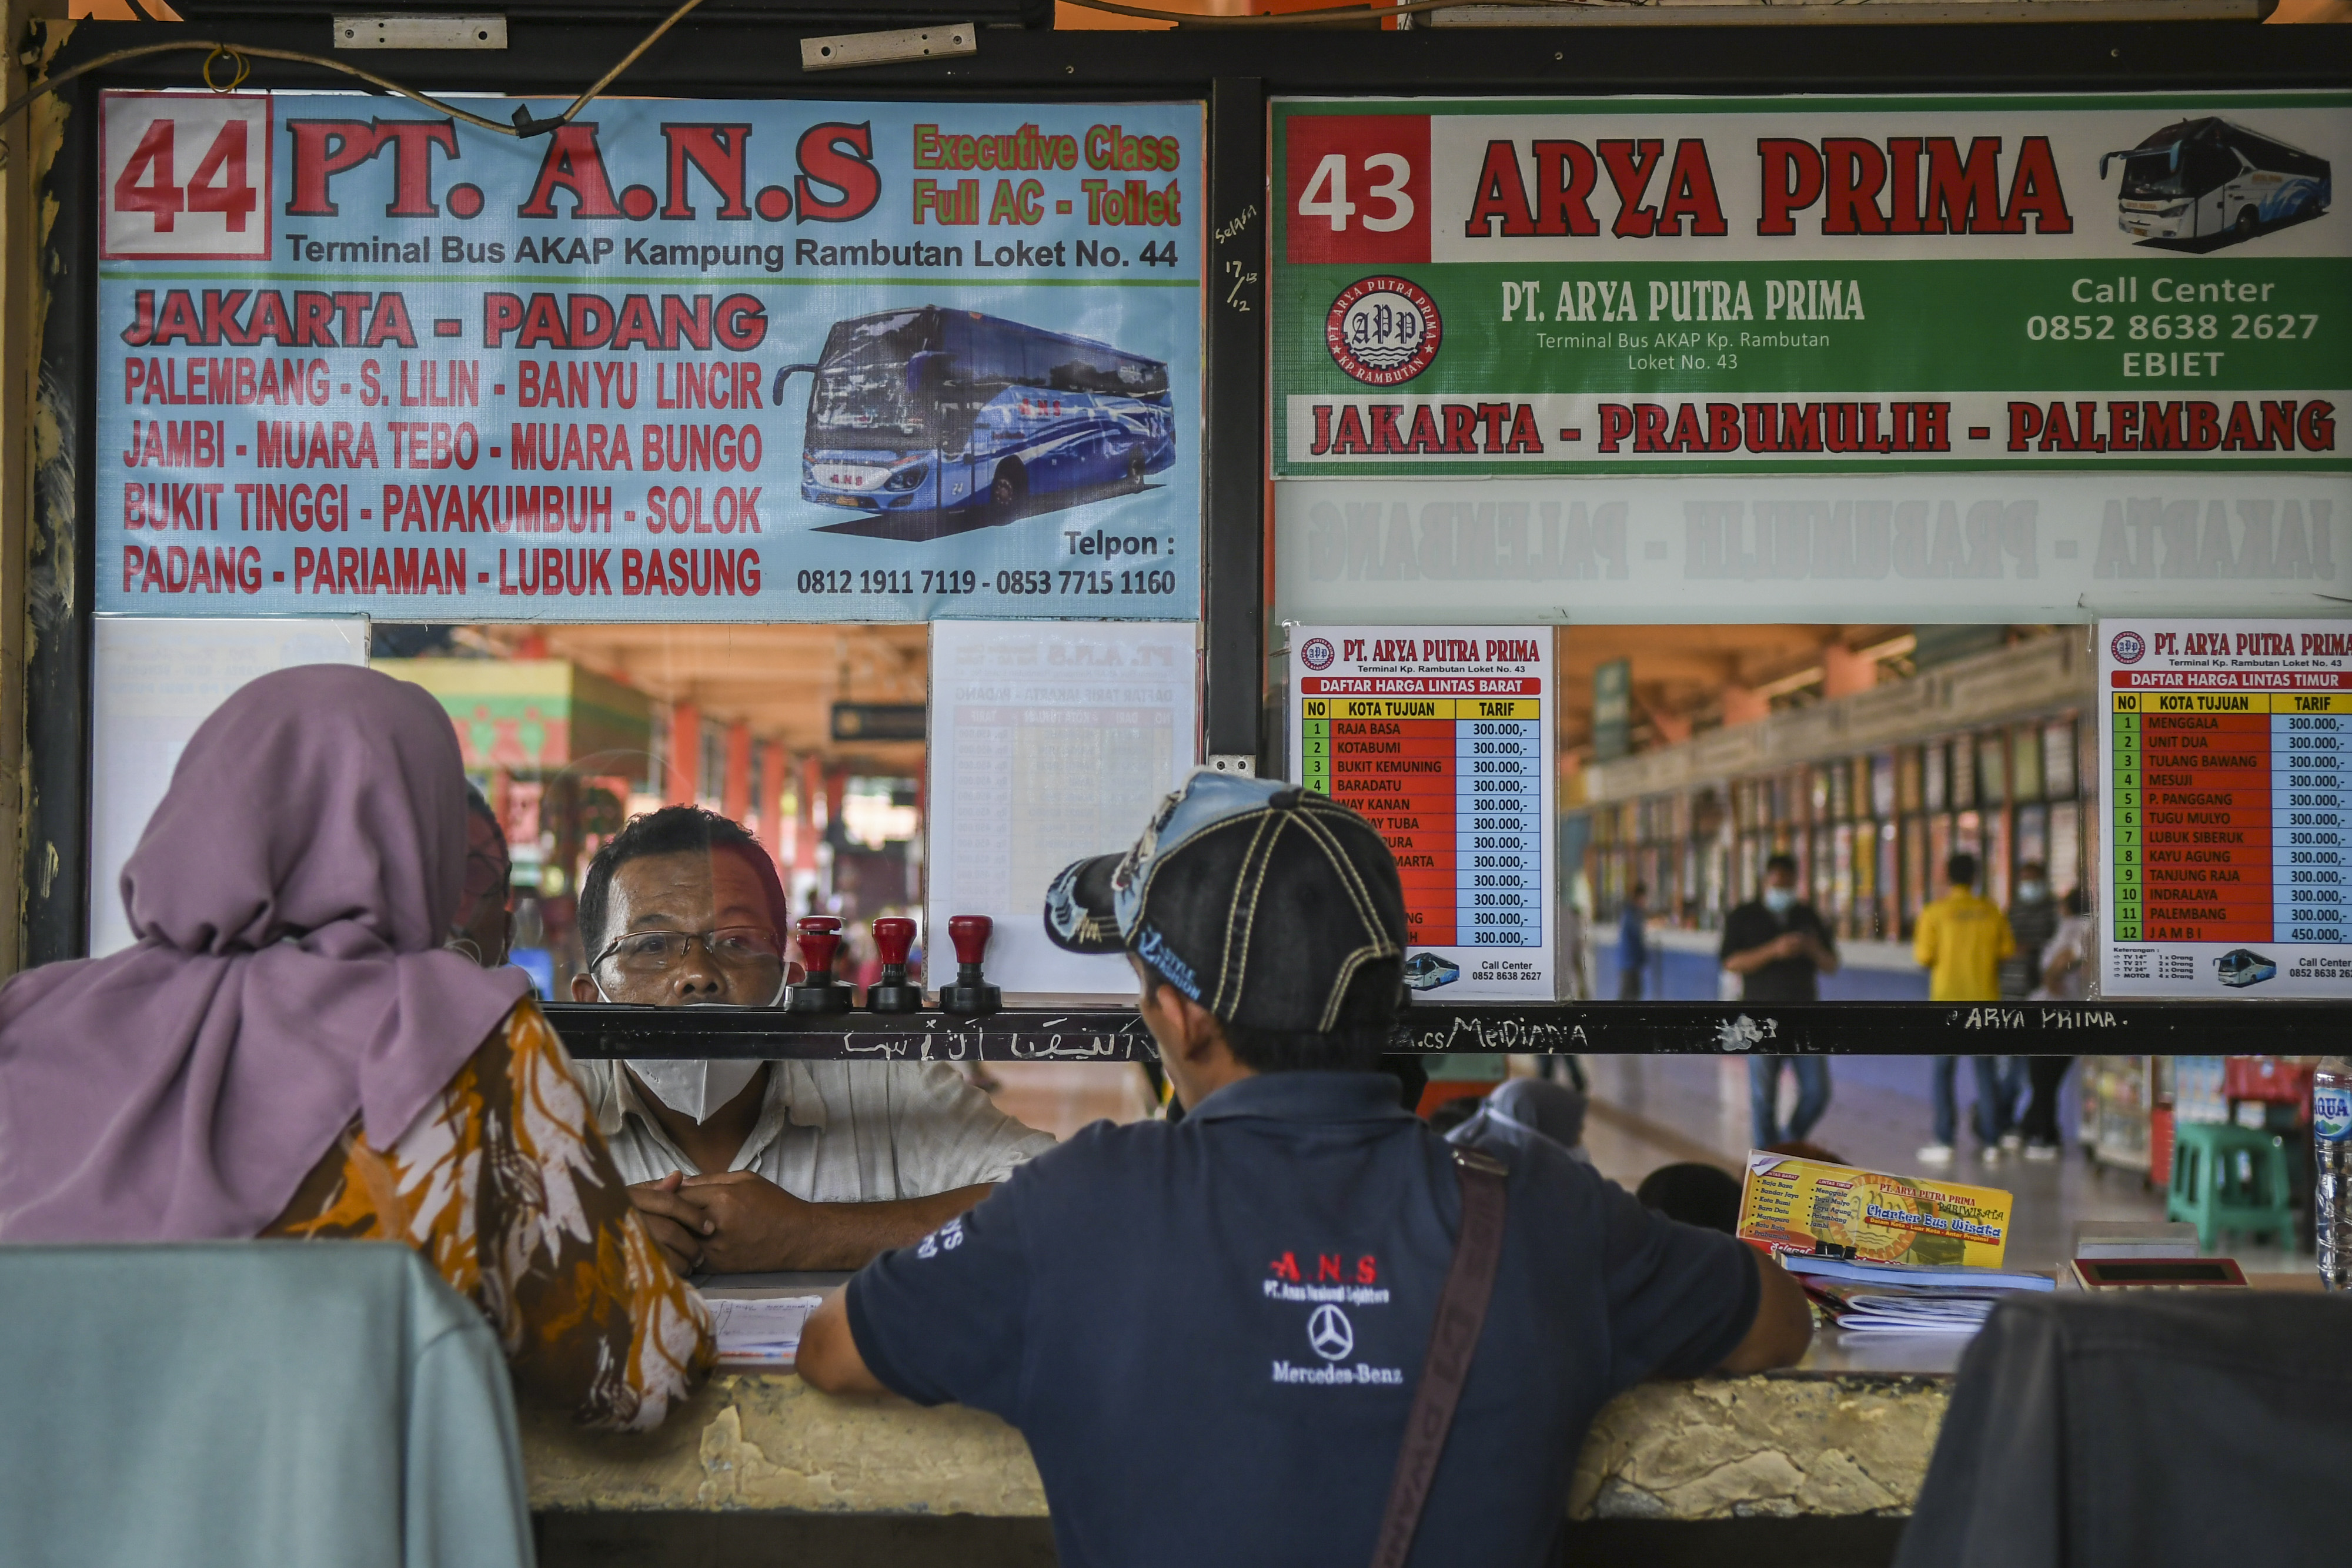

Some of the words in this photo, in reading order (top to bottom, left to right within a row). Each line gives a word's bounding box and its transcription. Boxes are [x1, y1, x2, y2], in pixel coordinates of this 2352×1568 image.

[913, 122, 1077, 171] Executive
[1085, 123, 1180, 172] Class
[113, 119, 258, 233] 44
[285, 115, 485, 219] PT.
[518, 120, 882, 226] A.N.S
[1297, 152, 1414, 233] 43
[1465, 138, 1729, 239] ARYA
[1757, 135, 2074, 236] PRIMA
[913, 178, 980, 226] Full
[988, 178, 1044, 226] AC
[1081, 178, 1181, 227] Toilet
[286, 234, 430, 263] Terminal
[442, 236, 505, 263] Bus
[513, 236, 614, 265] AKAP
[625, 238, 784, 272] Kampung
[796, 238, 963, 268] Rambutan
[975, 239, 1066, 268] Loket
[1075, 239, 1130, 268] No.
[1139, 240, 1178, 268] 44
[1501, 280, 1546, 323] PT.
[1555, 280, 1638, 322] ARYA
[1649, 280, 1753, 322] PUTRA
[1766, 279, 1866, 322] PRIMA
[2072, 276, 2137, 304] Call
[2151, 278, 2275, 304] Center
[119, 289, 418, 348] JAKARTA
[483, 292, 768, 352] PADANG
[1328, 323, 1339, 342] PT.
[1334, 287, 1362, 317] ARYA
[1367, 280, 1412, 297] PUTRA
[1415, 297, 1436, 339] PRIMA
[2026, 314, 2116, 342] 0852
[2129, 314, 2218, 340] 8638
[2231, 313, 2320, 340] 2627
[1536, 331, 1612, 350] Terminal
[1618, 331, 1649, 350] Bus
[1655, 331, 1701, 349] AKAP
[1707, 331, 1734, 353] Kp.
[1740, 330, 1830, 348] Rambutan
[1357, 357, 1424, 383] RAMBUTAN
[1628, 353, 1676, 372] Loket
[1681, 353, 1712, 372] No.
[1716, 353, 1738, 370] 43
[2122, 352, 2224, 378] EBIET
[125, 357, 330, 406] PALEMBANG
[360, 359, 389, 407] S.
[400, 359, 479, 407] LILIN
[519, 360, 637, 409] BANYU
[656, 362, 763, 410] LINCIR
[1309, 401, 1544, 456] JAKARTA
[1598, 401, 1952, 454] PRABUMULIH
[2007, 398, 2336, 454] PALEMBANG
[123, 420, 225, 469] JAMBI
[257, 420, 379, 470] MUARA
[388, 422, 479, 471] TEBO
[512, 423, 633, 471] MUARA
[642, 424, 762, 473] BUNGO
[123, 483, 223, 531] BUKIT
[235, 483, 348, 533] TINGGI
[383, 484, 612, 534] PAYAKUMBUH
[646, 486, 762, 535] SOLOK
[1065, 530, 1158, 560] Telpon
[123, 544, 262, 594] PADANG
[293, 547, 466, 596] PARIAMAN
[499, 548, 612, 597] LUBUK
[622, 548, 761, 597] BASUNG
[797, 569, 852, 595] 0812
[860, 569, 913, 595] 1911
[920, 569, 976, 595] 7119
[996, 569, 1052, 595] 0853
[1060, 569, 1114, 595] 7715
[1121, 569, 1175, 595] 1160
[1344, 639, 1367, 662] PT.
[1372, 639, 1417, 663] ARYA
[1423, 639, 1479, 663] PUTRA
[1486, 640, 1540, 662] PRIMA
[2154, 633, 2180, 656] PT.
[2184, 633, 2231, 656] ARYA
[2236, 633, 2294, 656] PUTRA
[1358, 665, 1397, 673] Terminal
[1400, 665, 1416, 674] Kp.
[1418, 665, 1465, 673] Rambutan
[1468, 665, 1494, 673] Loket
[1515, 665, 1525, 673] 43
[2131, 673, 2183, 686] DAFTAR
[2188, 674, 2236, 686] HARGA
[2243, 674, 2290, 687] LINTAS
[2295, 674, 2338, 687] TIMUR
[1321, 679, 1372, 692] DAFTAR
[1376, 680, 1425, 693] HARGA
[1428, 680, 1475, 693] LINTAS
[1479, 680, 1522, 692] BARAT
[1308, 702, 1325, 716] NO
[1349, 702, 1382, 716] KOTA
[1385, 703, 1435, 716] TUJUAN
[1479, 703, 1515, 716] TARIF
[2118, 696, 2136, 710] NO
[2160, 696, 2194, 710] KOTA
[2197, 697, 2249, 710] TUJUAN
[2295, 697, 2330, 710] TARIF
[1314, 723, 1321, 734] 1
[1338, 723, 1367, 735] RAJA
[1370, 723, 1401, 735] BASA
[1474, 723, 1528, 737] 300.000,-
[2125, 718, 2132, 728] 1
[2149, 717, 2219, 729] MENGGALA
[2289, 718, 2344, 731] 300.000,-
[1314, 742, 1321, 753] 2
[1338, 742, 1401, 754] KOTABUMI
[1474, 742, 1528, 756] 300.000,-
[1314, 761, 1321, 772] 3
[1338, 761, 1372, 773] BUKIT
[1376, 761, 1442, 773] KEMUNING
[1474, 761, 1528, 775] 300.000,-
[1314, 780, 1321, 791] 4
[1338, 780, 1402, 791] BARADATU
[1474, 780, 1528, 794] 300.000,-
[1368, 799, 1410, 810] KANAN
[1474, 799, 1528, 813] 300.000,-
[1472, 972, 1495, 981] 0852
[1497, 972, 1519, 980] 8638
[1521, 972, 1541, 980] 2627
[1482, 961, 1499, 969] Call
[1502, 961, 1532, 969] Center
[1965, 1008, 2025, 1030] ARYA
[1815, 1188, 1847, 1198] Menggala
[1880, 1183, 1893, 1192] PT.
[1896, 1186, 1916, 1196] ARYA
[1919, 1190, 1946, 1202] PUTRA
[1949, 1195, 1975, 1206] PRIMA
[1812, 1213, 1847, 1224] Palembang
[1866, 1204, 1920, 1223] Charter
[1923, 1214, 1947, 1229] Bus
[1952, 1219, 2002, 1238] Wisata
[1937, 1202, 2004, 1221] PARIWISATA
